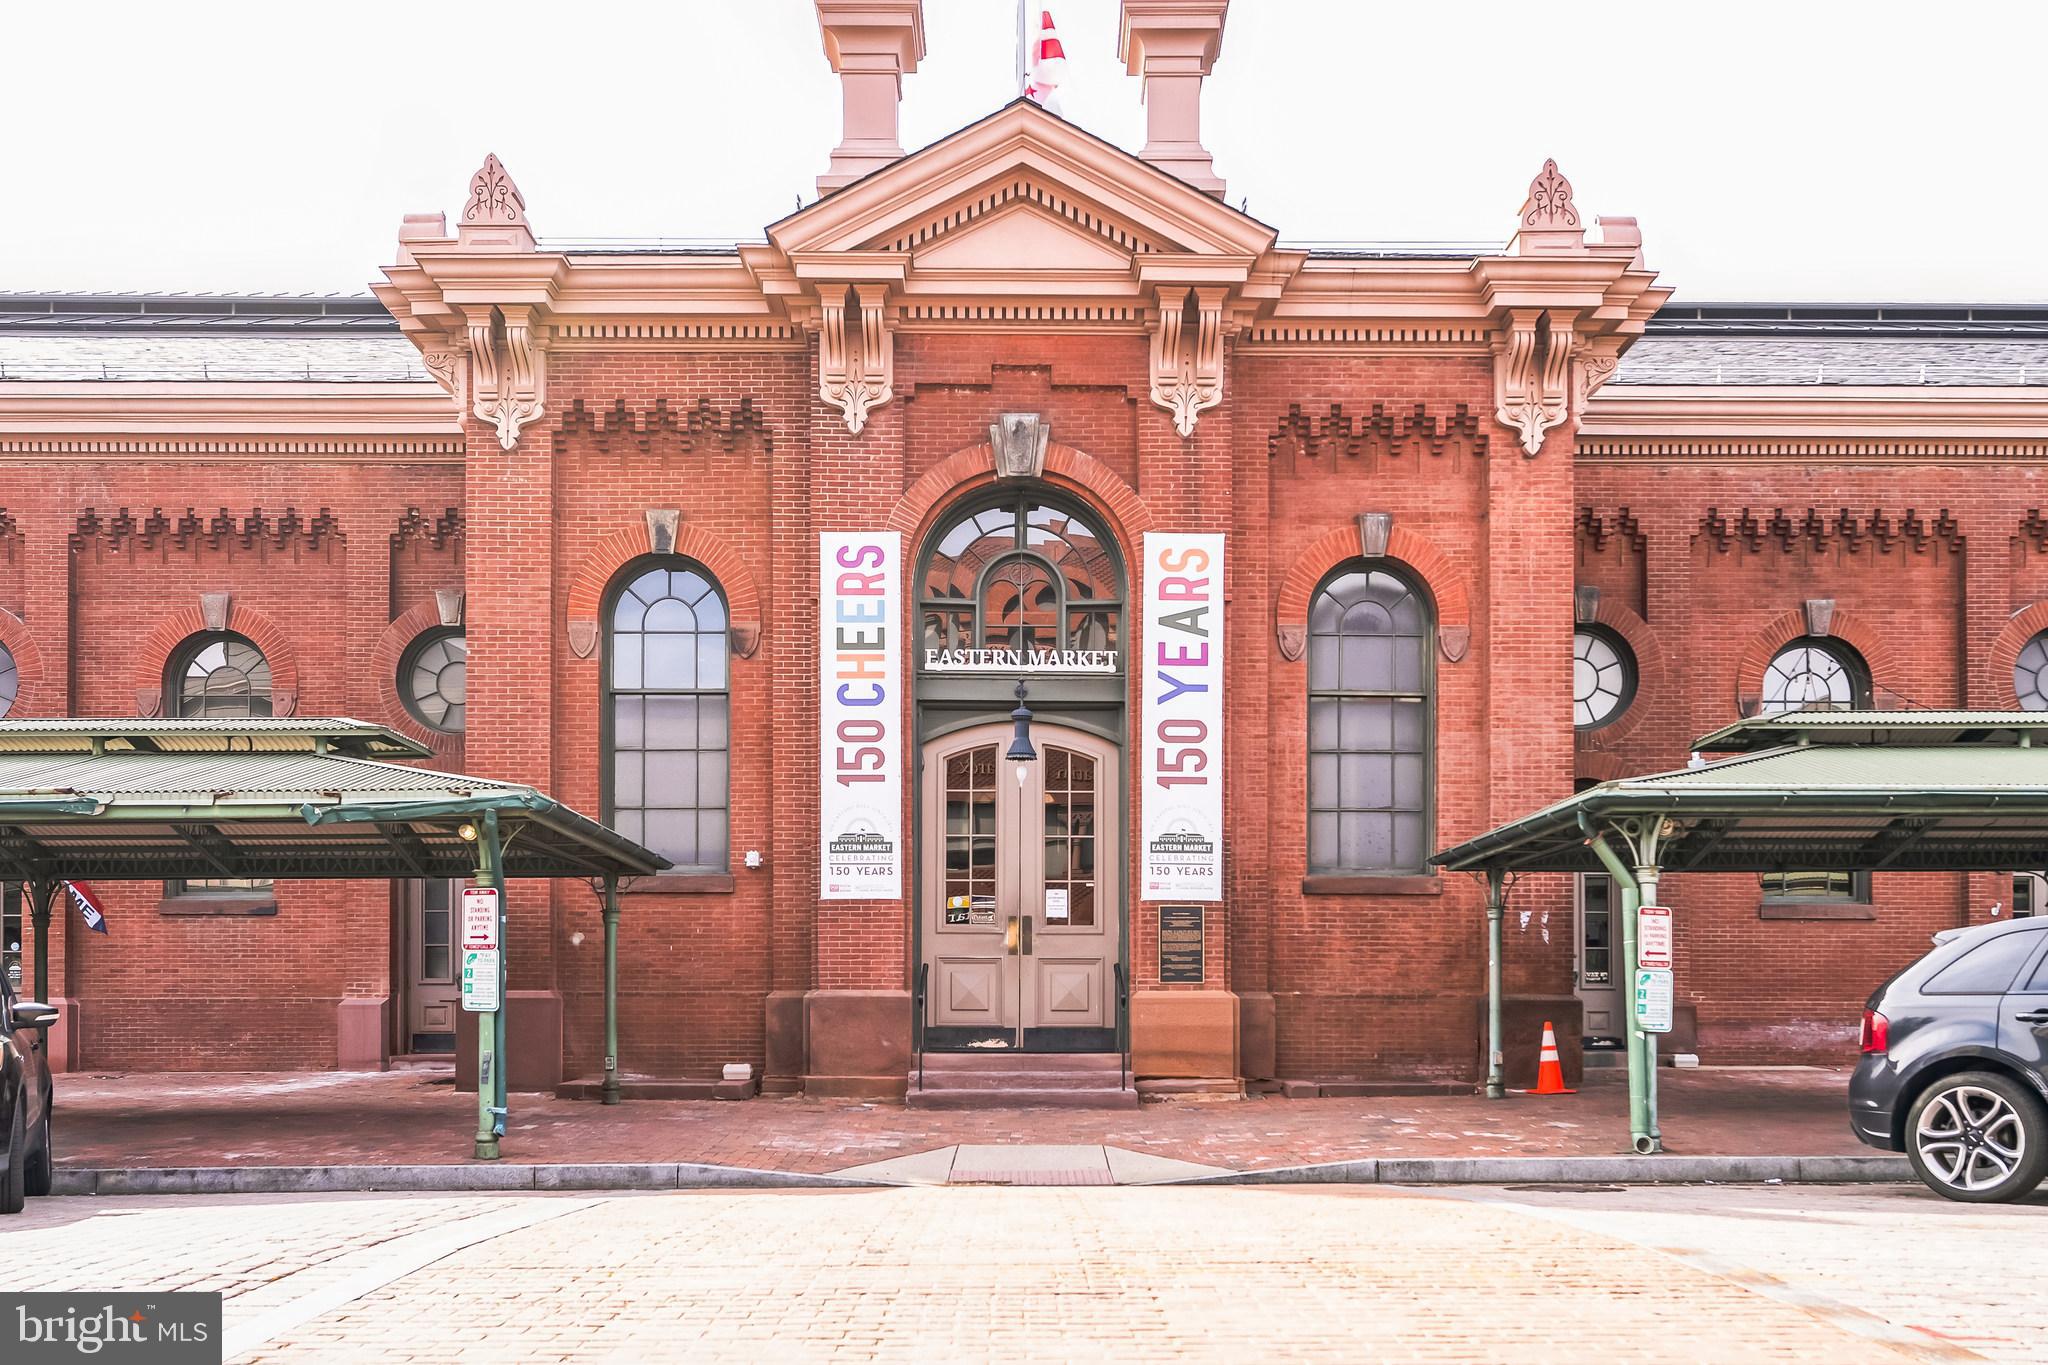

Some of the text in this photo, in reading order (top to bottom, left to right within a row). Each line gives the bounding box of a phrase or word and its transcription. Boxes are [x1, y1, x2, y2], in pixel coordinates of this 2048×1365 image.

[836, 545, 886, 707] CHEERS
[1157, 548, 1210, 706] YEARS
[924, 648, 1118, 669] EASTERN MARKET
[836, 719, 886, 788] 150
[1156, 719, 1208, 790] 150
[1183, 844, 1212, 852] MARKET
[829, 854, 894, 862] CELEBRATING
[1149, 854, 1214, 862] CELEBRATING
[829, 866, 893, 876] 150 YEARS
[1149, 866, 1214, 876] 150 YEARS
